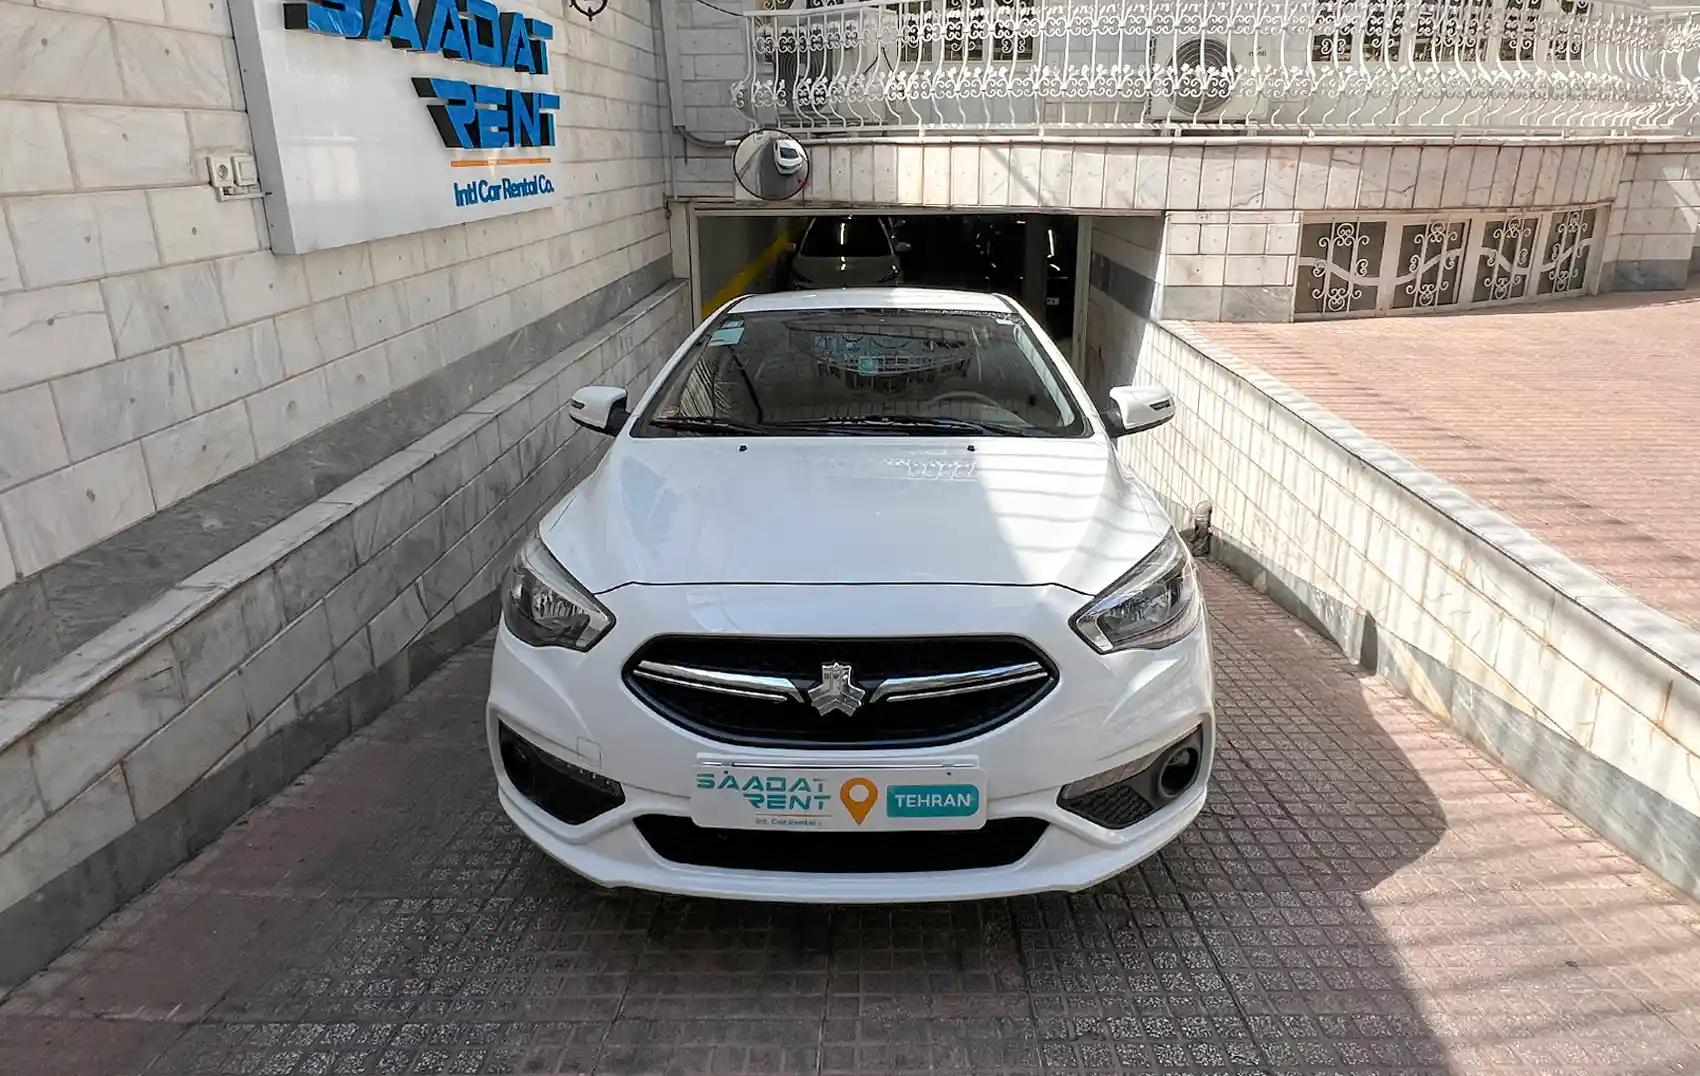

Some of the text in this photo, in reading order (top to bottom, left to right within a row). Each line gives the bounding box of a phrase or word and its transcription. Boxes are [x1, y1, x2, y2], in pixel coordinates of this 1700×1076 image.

[412, 77, 560, 149] RENT
[479, 179, 502, 202] Car
[502, 176, 538, 199] Rental
[538, 174, 554, 194] Co.
[697, 773, 829, 792] SAADAT
[743, 794, 831, 810] RENT
[895, 793, 971, 808] TEHRAN
